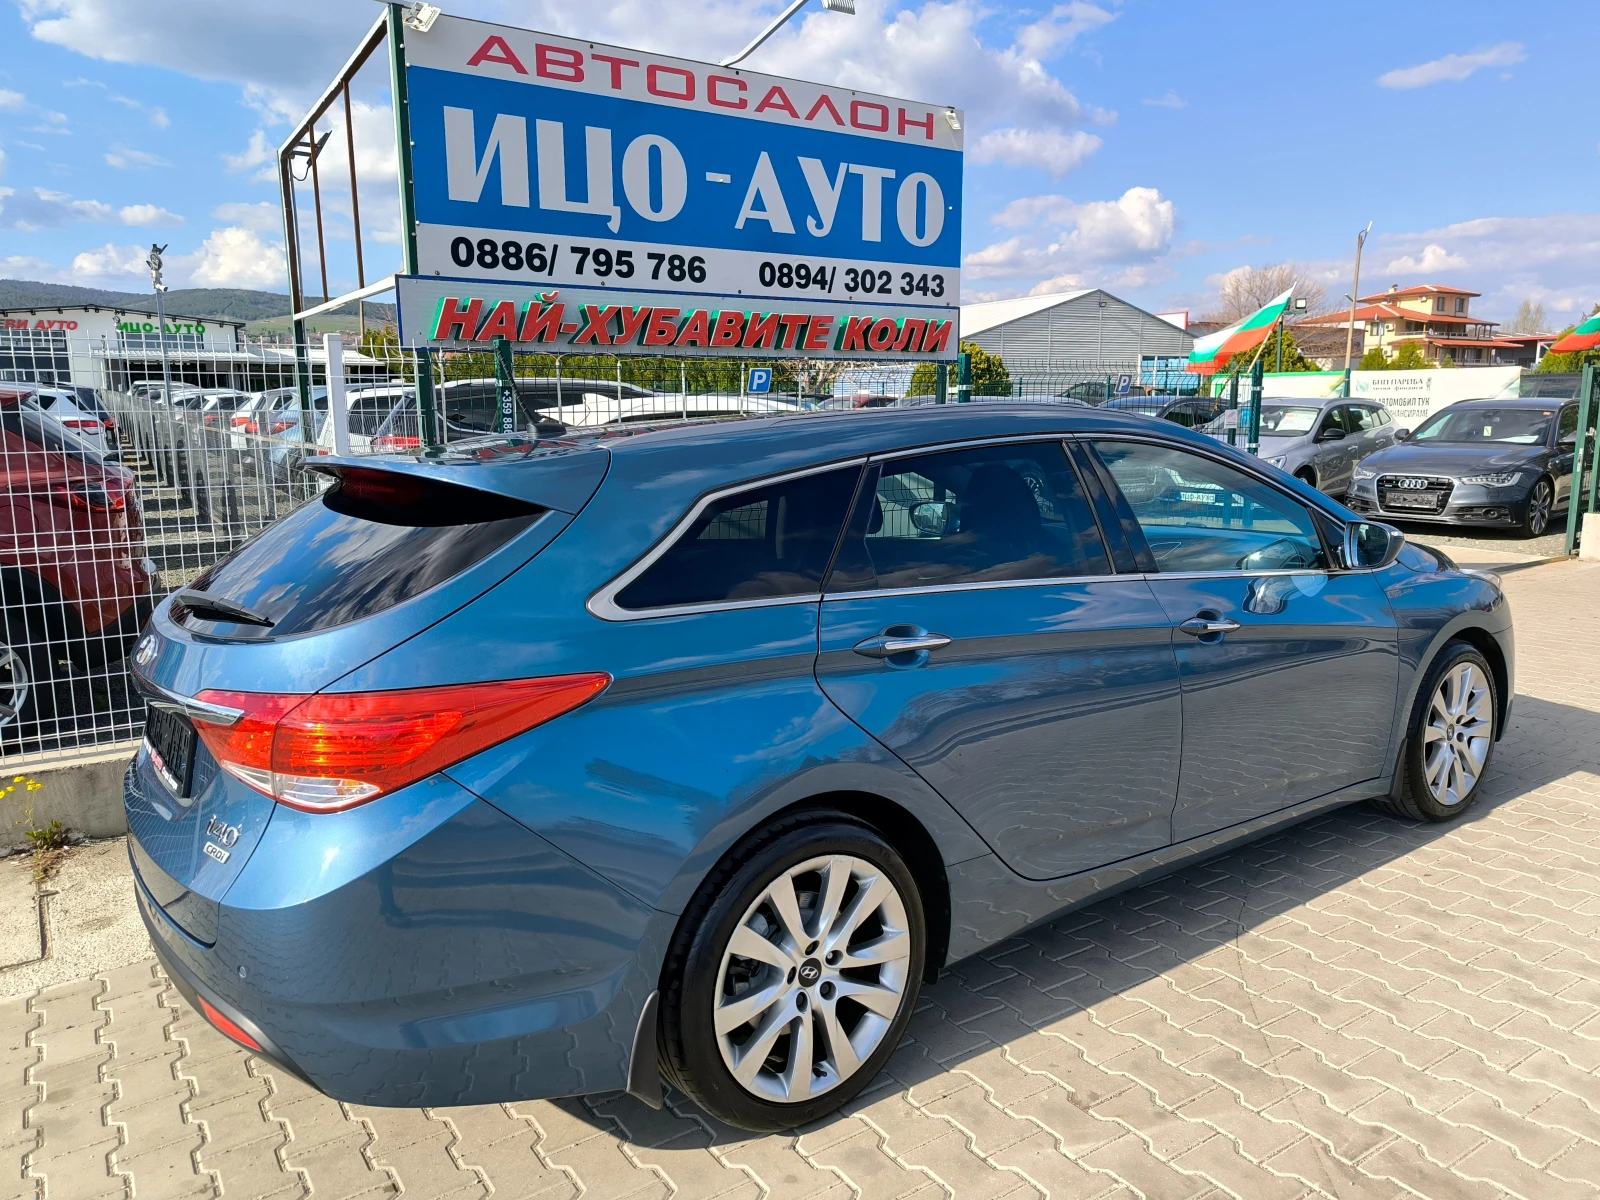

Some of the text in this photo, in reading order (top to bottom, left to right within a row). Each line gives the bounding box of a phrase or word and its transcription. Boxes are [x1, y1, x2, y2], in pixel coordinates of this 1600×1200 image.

[466, 35, 935, 140] АВТОСАЛОН
[450, 236, 707, 284] 0886/ 795 786
[758, 261, 946, 298] 0894/ 302 343
[34, 320, 78, 331] АУТО
[431, 290, 954, 353] НАЙ-ХУБАВИТЕ КОЛИ
[502, 390, 513, 415] +359
[1417, 397, 1430, 406] ТУК
[206, 814, 240, 848] i40
[206, 844, 226, 861] CRDi
